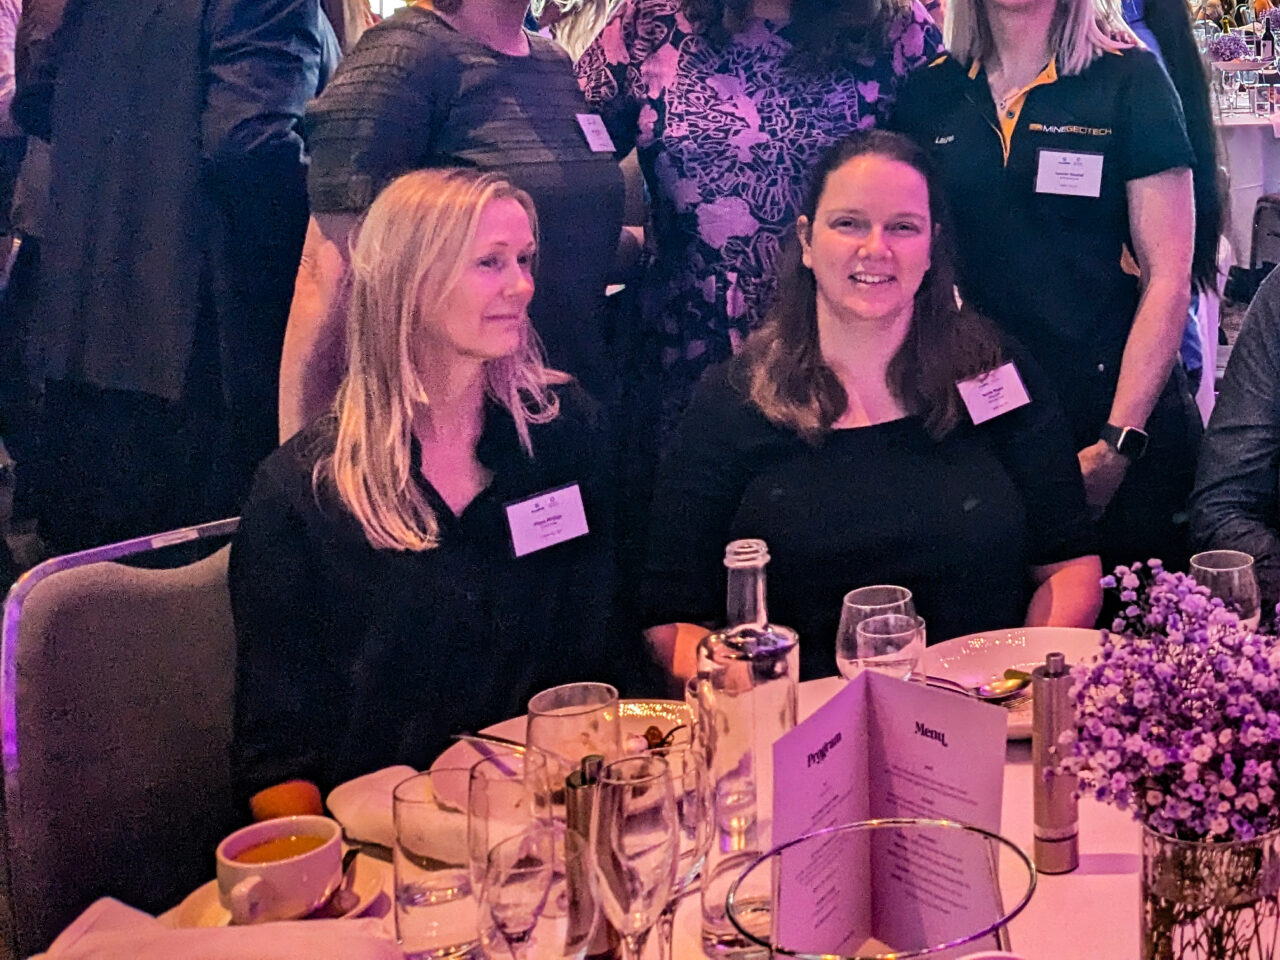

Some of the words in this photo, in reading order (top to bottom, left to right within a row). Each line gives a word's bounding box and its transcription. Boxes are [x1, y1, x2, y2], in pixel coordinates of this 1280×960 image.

[1042, 124, 1113, 136] MINEGEOTECH
[915, 721, 948, 747] Menu
[807, 732, 842, 768] Program
